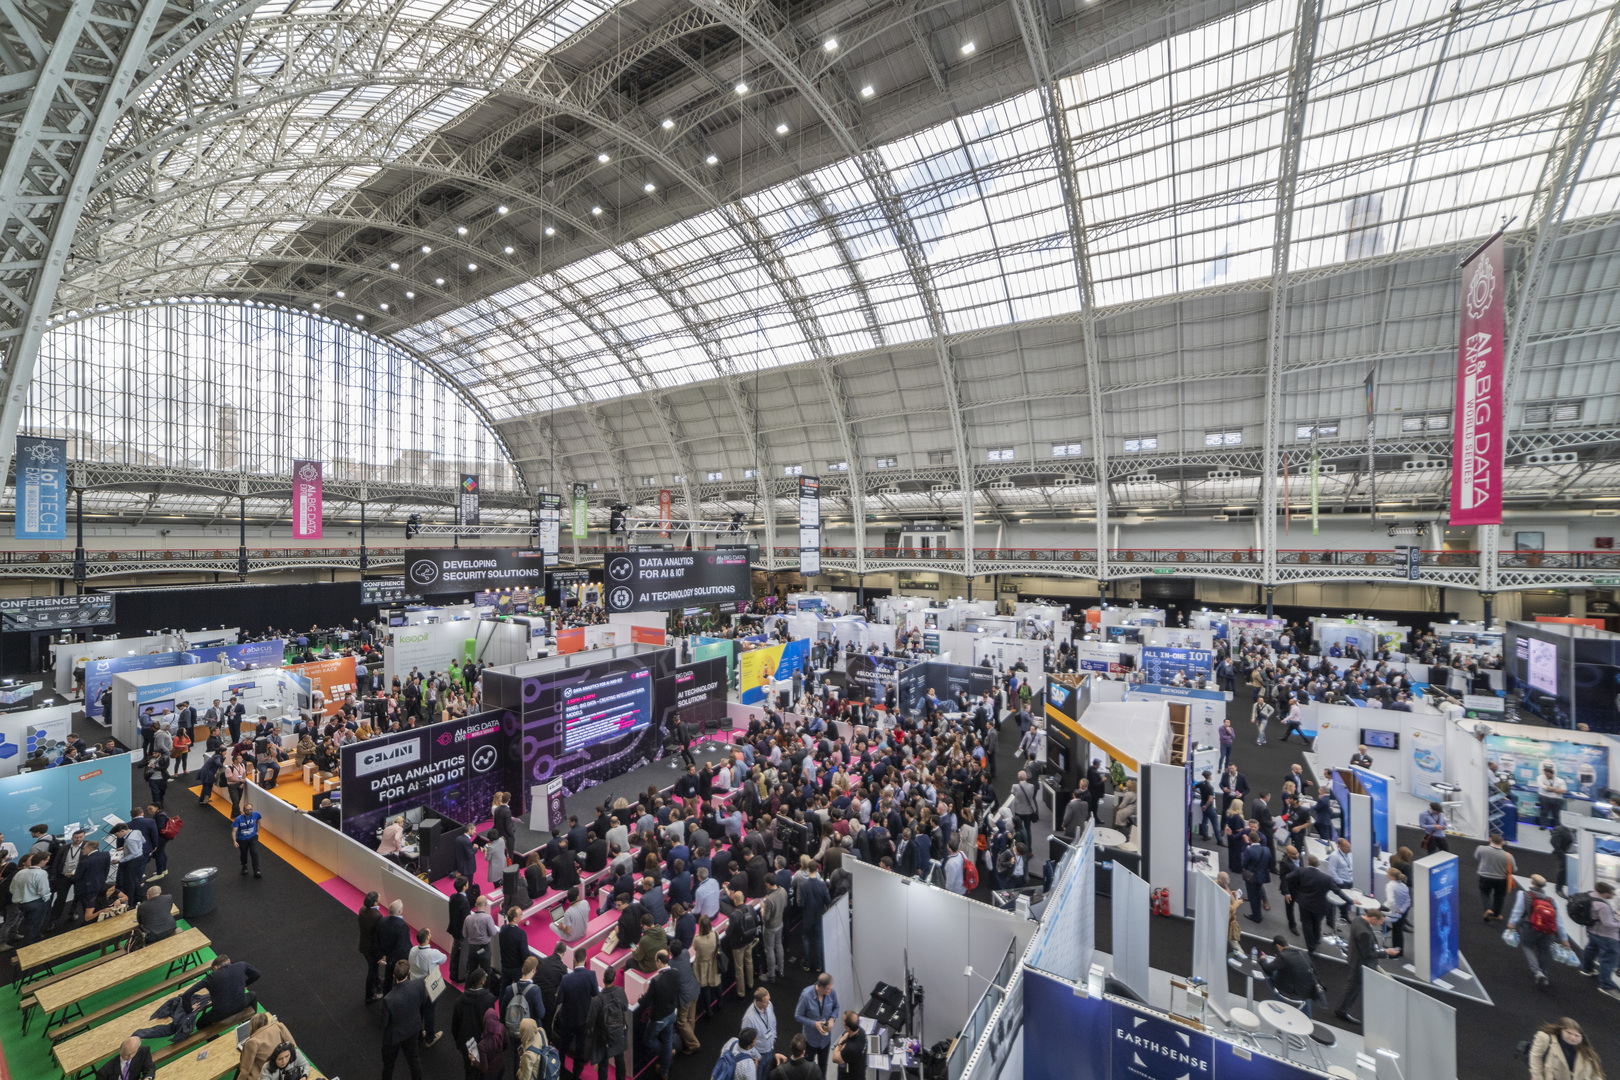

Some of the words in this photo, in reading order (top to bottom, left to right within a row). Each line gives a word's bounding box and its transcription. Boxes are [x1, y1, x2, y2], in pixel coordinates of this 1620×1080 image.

[1465, 333, 1480, 375] EXPO
[1478, 332, 1492, 358] AI
[1477, 361, 1486, 374] &
[1476, 375, 1491, 426] BIG
[1465, 399, 1474, 440] WORLD
[26, 467, 40, 486] EXPO
[41, 468, 58, 490] IoT
[1474, 433, 1490, 508] DATA
[40, 492, 58, 533] TECH
[308, 498, 316, 511] BIG
[308, 514, 316, 534] DATA
[443, 559, 497, 569] DEVELOPING
[640, 558, 663, 567] DATA
[664, 557, 694, 566] ANALYTICS
[443, 571, 487, 581] SECURITY
[488, 569, 539, 578] SOLUTIONS
[640, 570, 659, 579] FOR
[676, 568, 685, 576] IOT
[0, 598, 77, 608] ONFERENCE
[80, 596, 111, 604] ZONE
[640, 593, 649, 602] AI
[651, 588, 693, 600] TECHNOLOGY
[694, 585, 736, 596] SOLUTIONS
[1189, 652, 1210, 661] IOT
[140, 686, 172, 696] onelogin
[684, 681, 718, 696] TECHNOLOGY
[1051, 686, 1066, 707] SAP
[678, 693, 707, 707] SOLUTIONS
[467, 724, 480, 733] BIG
[481, 720, 500, 730] DATA
[371, 773, 403, 790] DATA
[405, 754, 465, 780] ANALYTICS
[378, 787, 404, 802] FOR
[447, 767, 466, 780] IOT
[1117, 1028, 1207, 1071] EARTHSENSE
